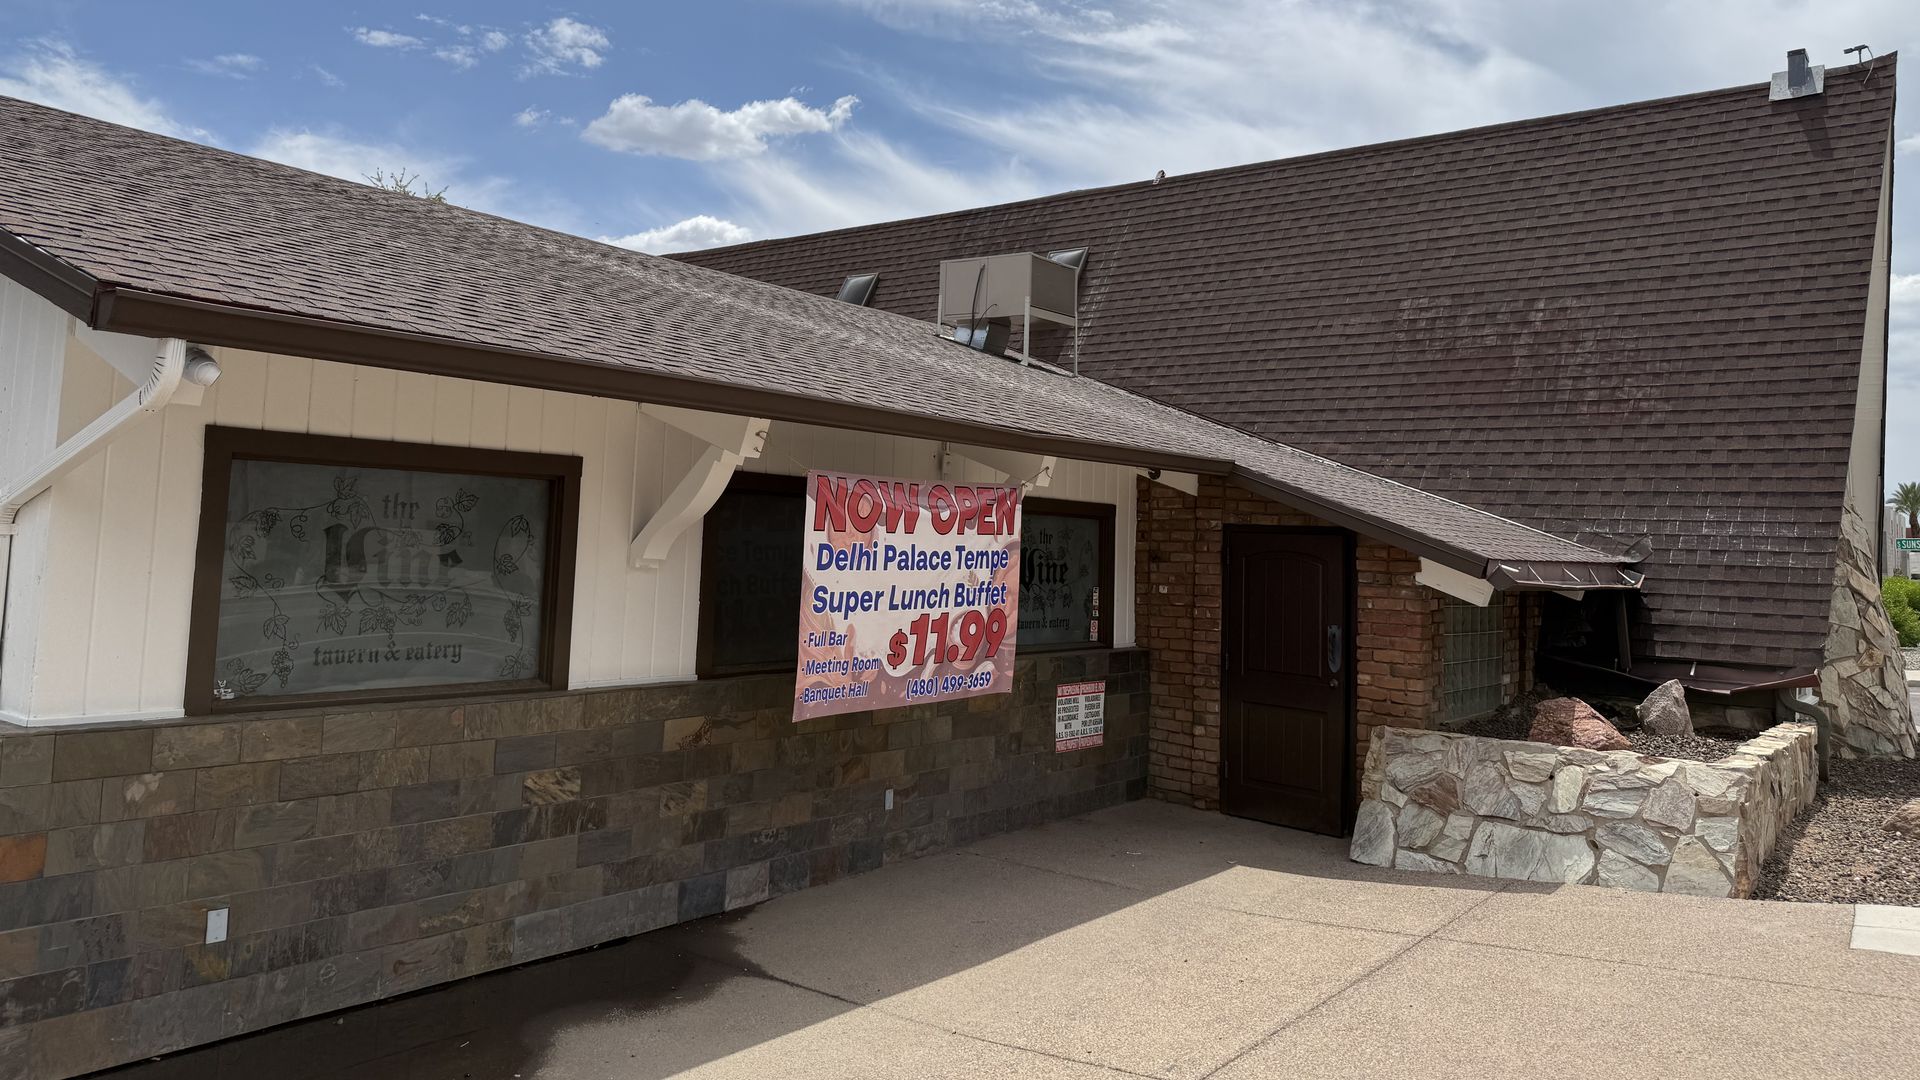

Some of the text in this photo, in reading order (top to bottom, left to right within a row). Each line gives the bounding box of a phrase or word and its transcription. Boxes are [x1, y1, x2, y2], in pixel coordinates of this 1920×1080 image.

[382, 493, 420, 521] the
[814, 475, 1018, 535] NOW OPEN
[816, 541, 1009, 575] Delhi Palace Tempe
[812, 580, 1007, 620] Super Lunch Buffet
[829, 631, 848, 646] Bar
[887, 607, 1008, 670] $11.99
[313, 640, 464, 667] tavern & eatery
[851, 656, 879, 671] Room
[848, 681, 869, 698] Hall
[906, 671, 992, 699] (480) 499-3659
